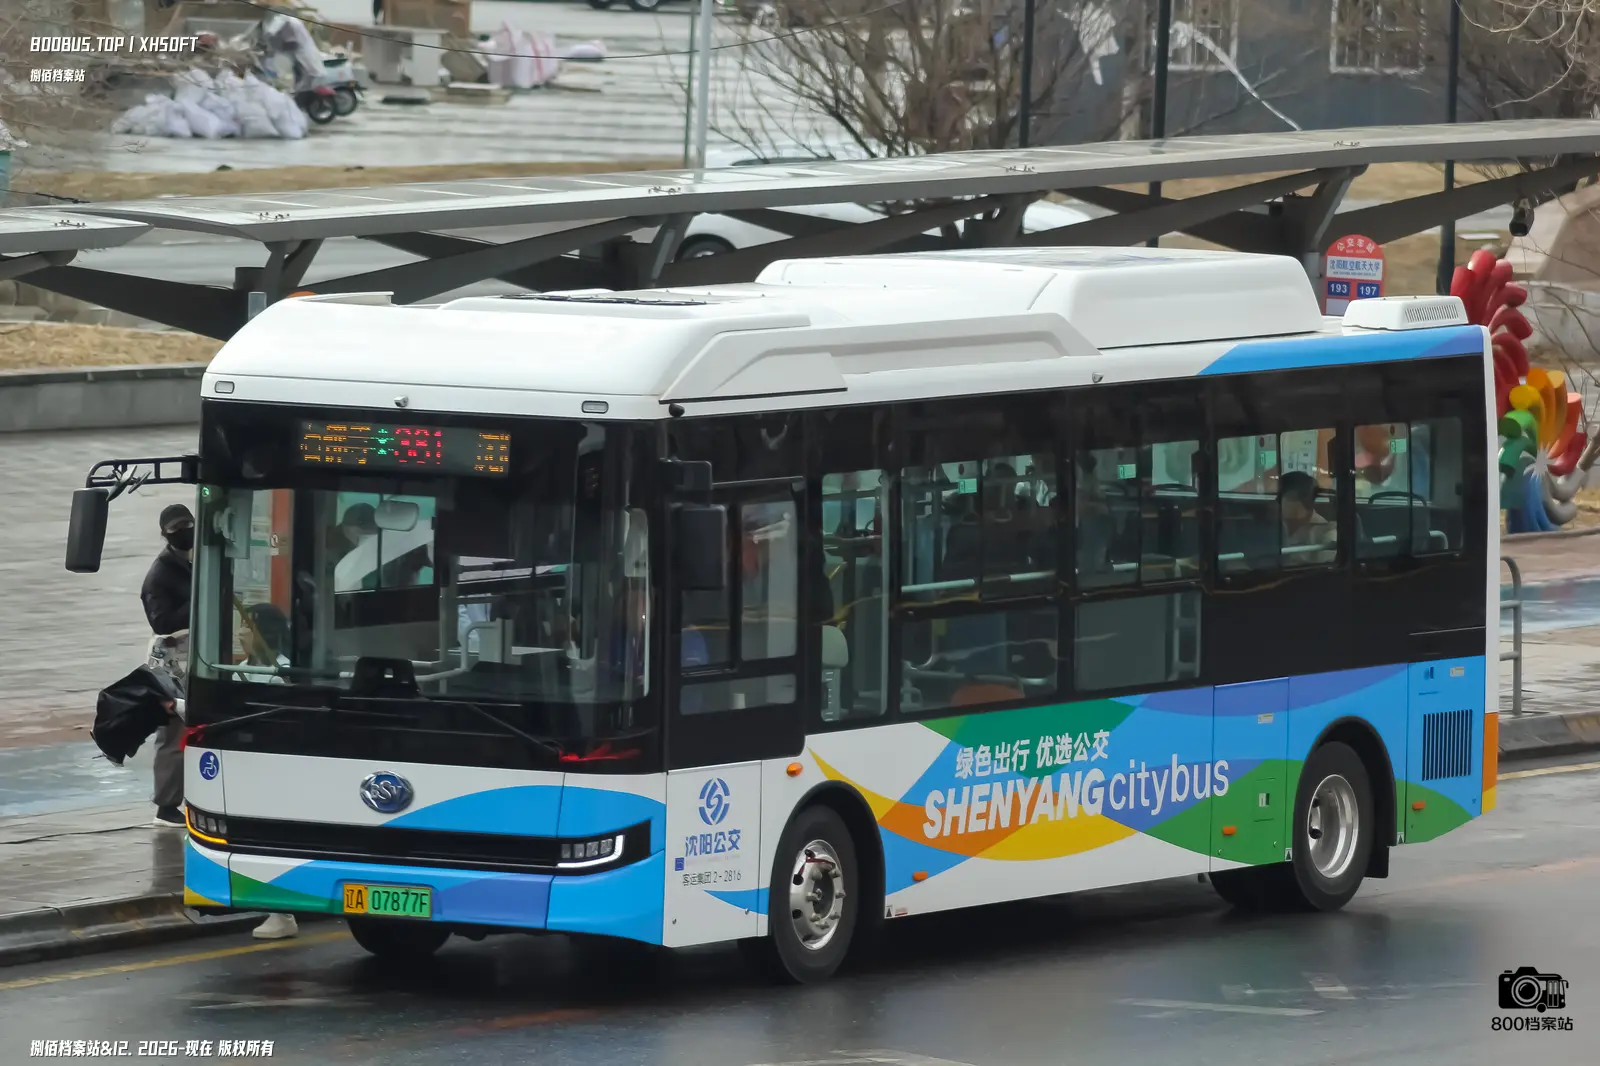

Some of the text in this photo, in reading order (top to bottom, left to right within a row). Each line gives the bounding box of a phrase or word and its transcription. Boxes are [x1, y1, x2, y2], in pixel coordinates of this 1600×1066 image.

[1330, 283, 1348, 294] 193
[1359, 286, 1377, 296] 197
[955, 729, 1110, 779] 绿色出行 优选公交
[685, 829, 741, 857] 沈阳公交
